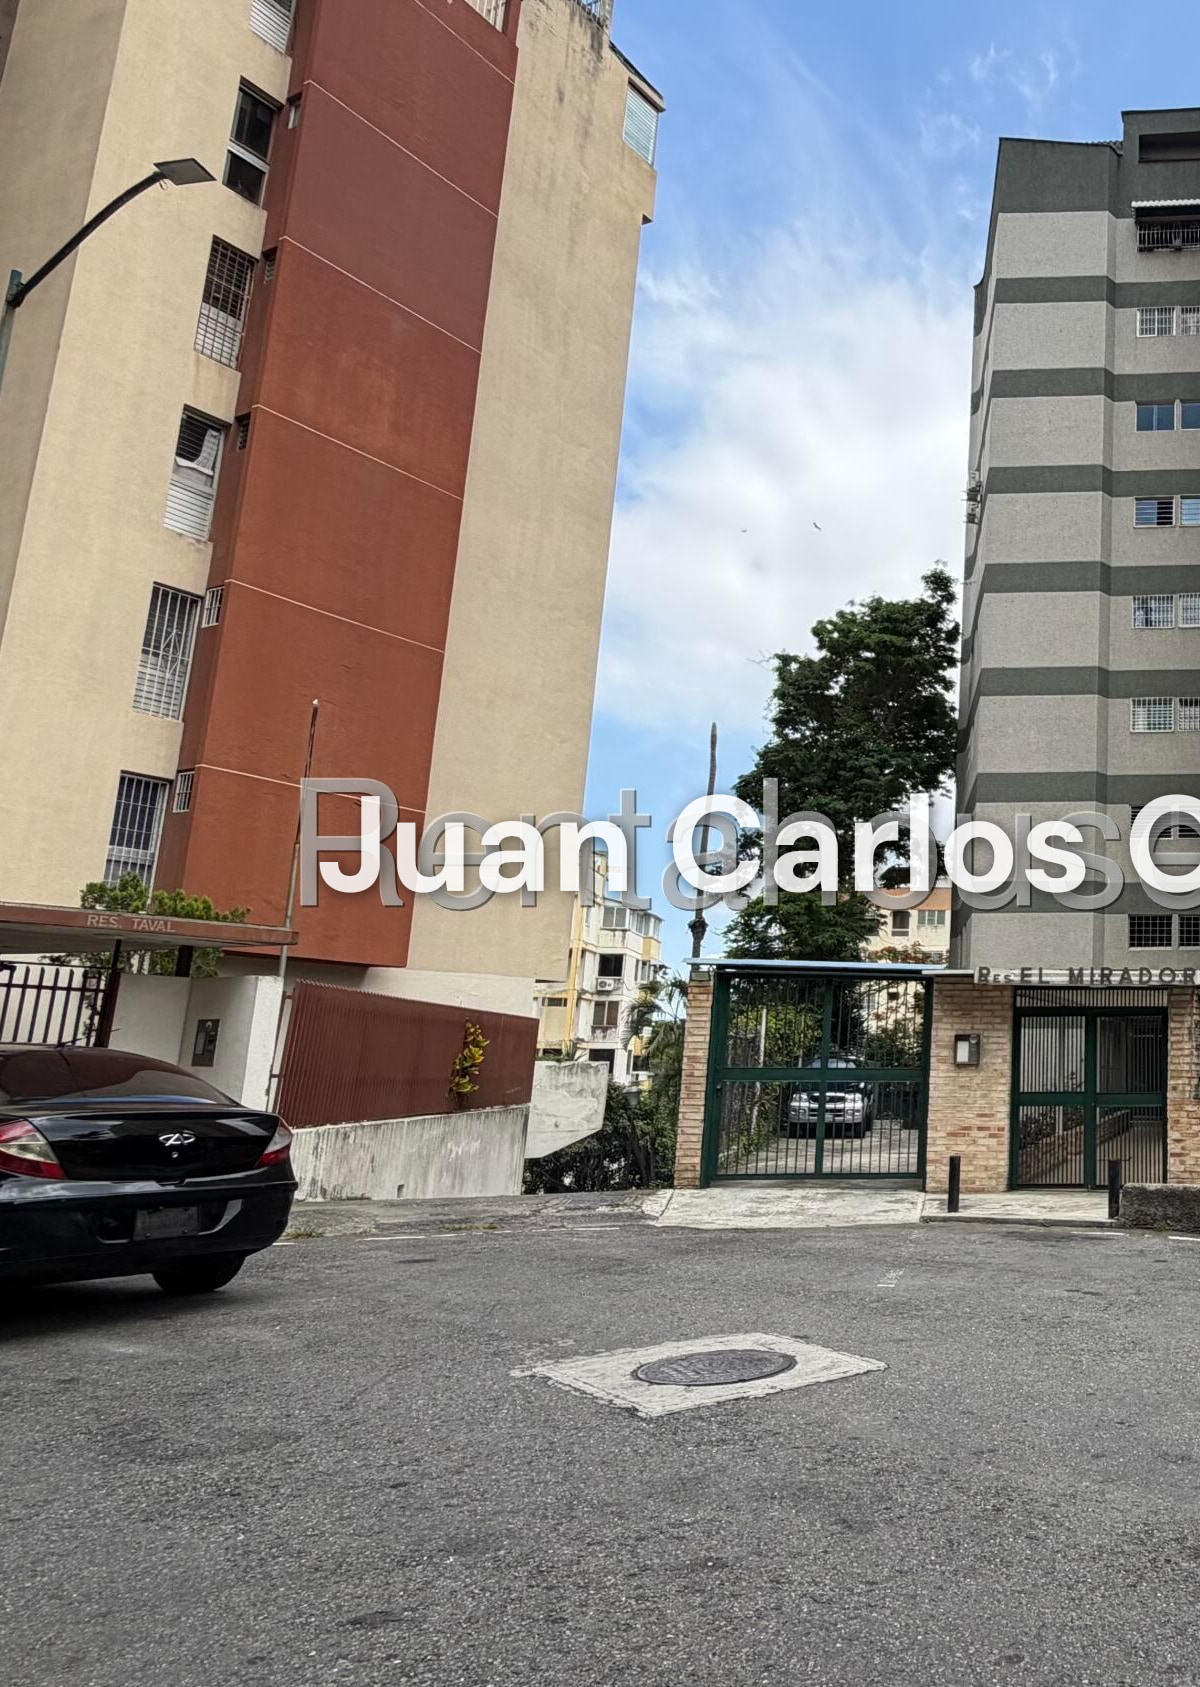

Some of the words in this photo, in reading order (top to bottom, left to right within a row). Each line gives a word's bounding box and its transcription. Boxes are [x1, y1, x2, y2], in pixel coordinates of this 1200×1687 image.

[132, 918, 176, 932] TAVAL
[1021, 966, 1050, 984] EL
[1068, 966, 1197, 985] MIRADOR
